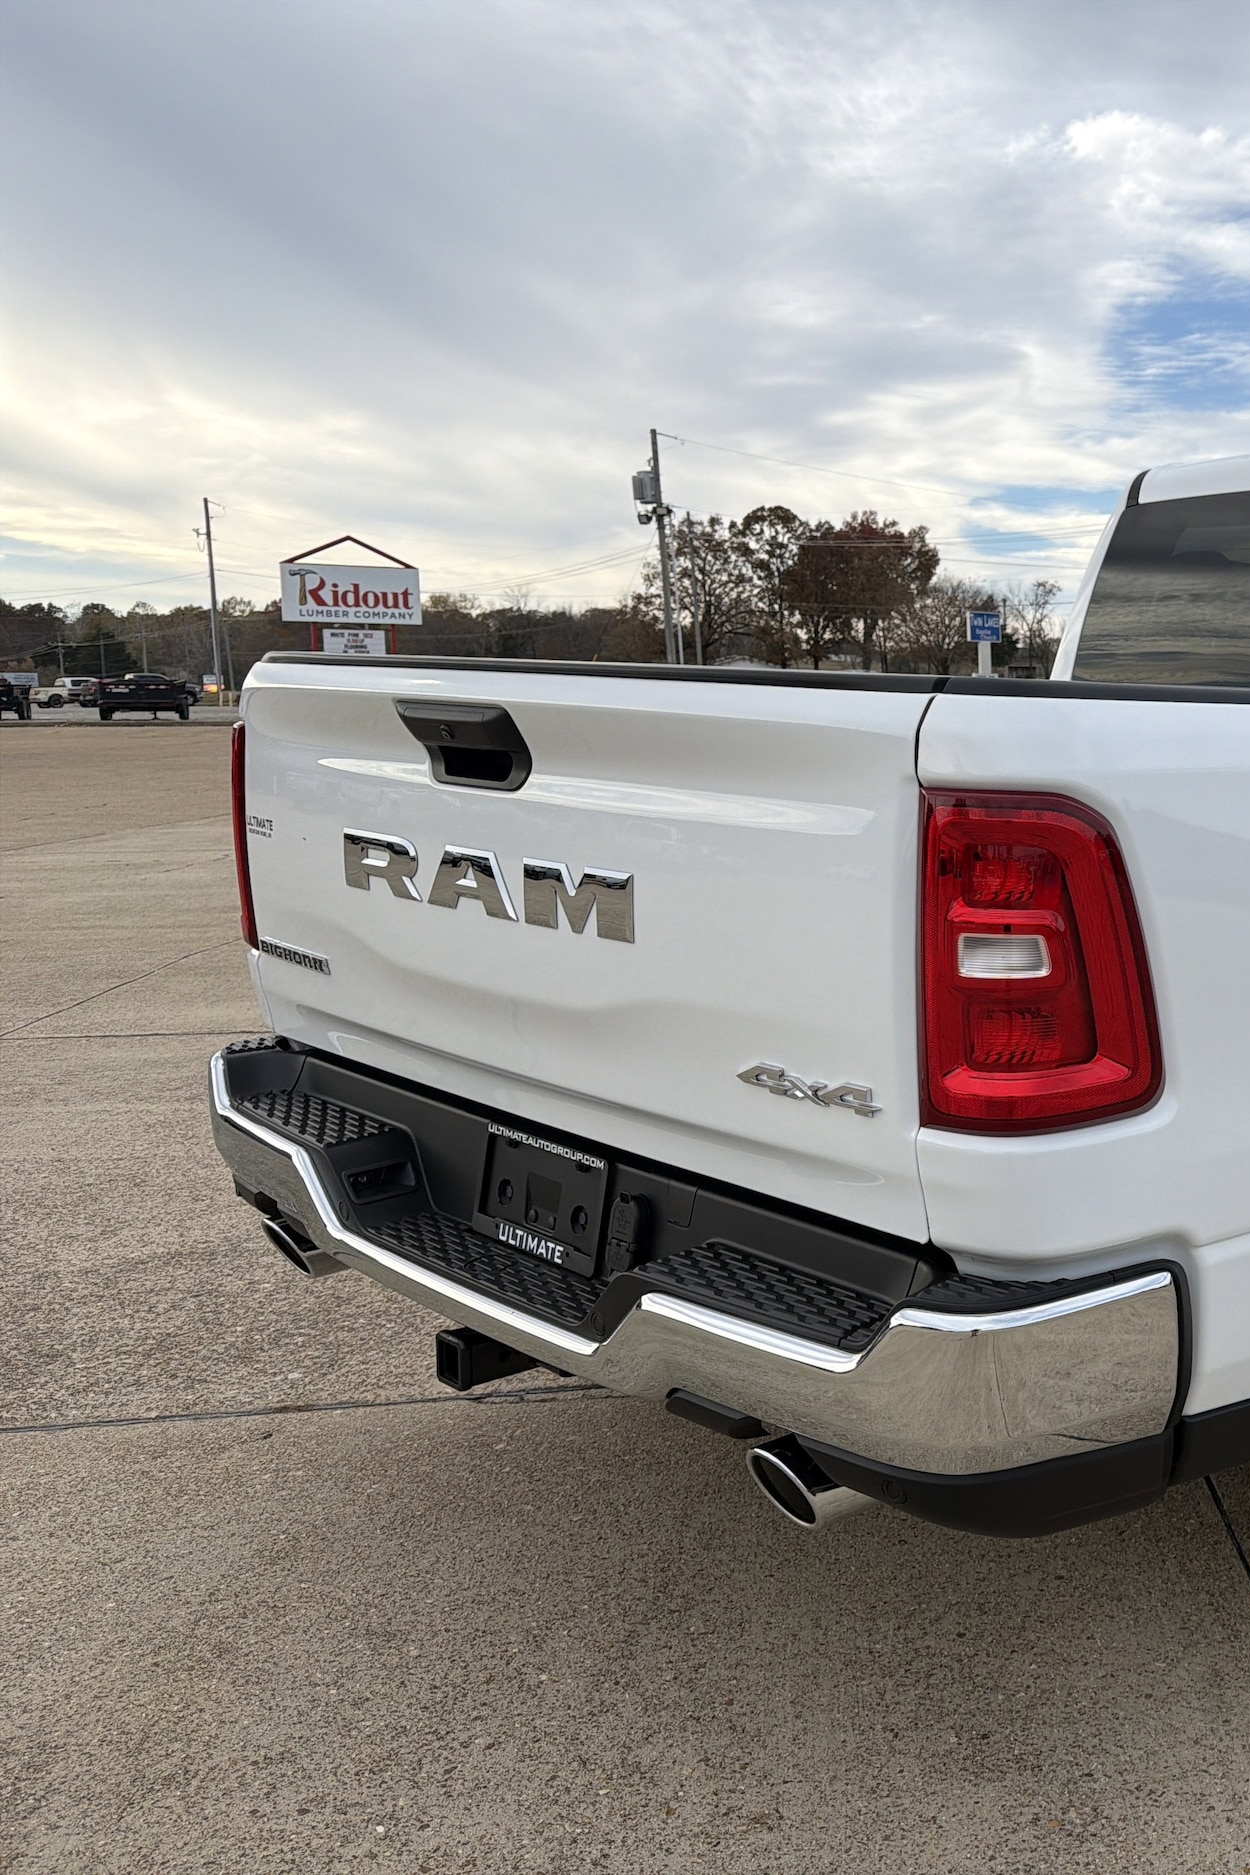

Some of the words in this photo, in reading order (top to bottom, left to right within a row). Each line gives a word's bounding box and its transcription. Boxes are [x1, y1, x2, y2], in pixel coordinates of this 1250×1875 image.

[289, 568, 414, 609] Ridout
[299, 609, 349, 618] LUMBER
[353, 610, 414, 619] COMPANY
[247, 814, 273, 831] ULTIMATE
[343, 827, 635, 944] RAM
[487, 1122, 605, 1170] ULTIMATEAUTOGROUP.COM
[498, 1222, 565, 1265] ULTIMATE
